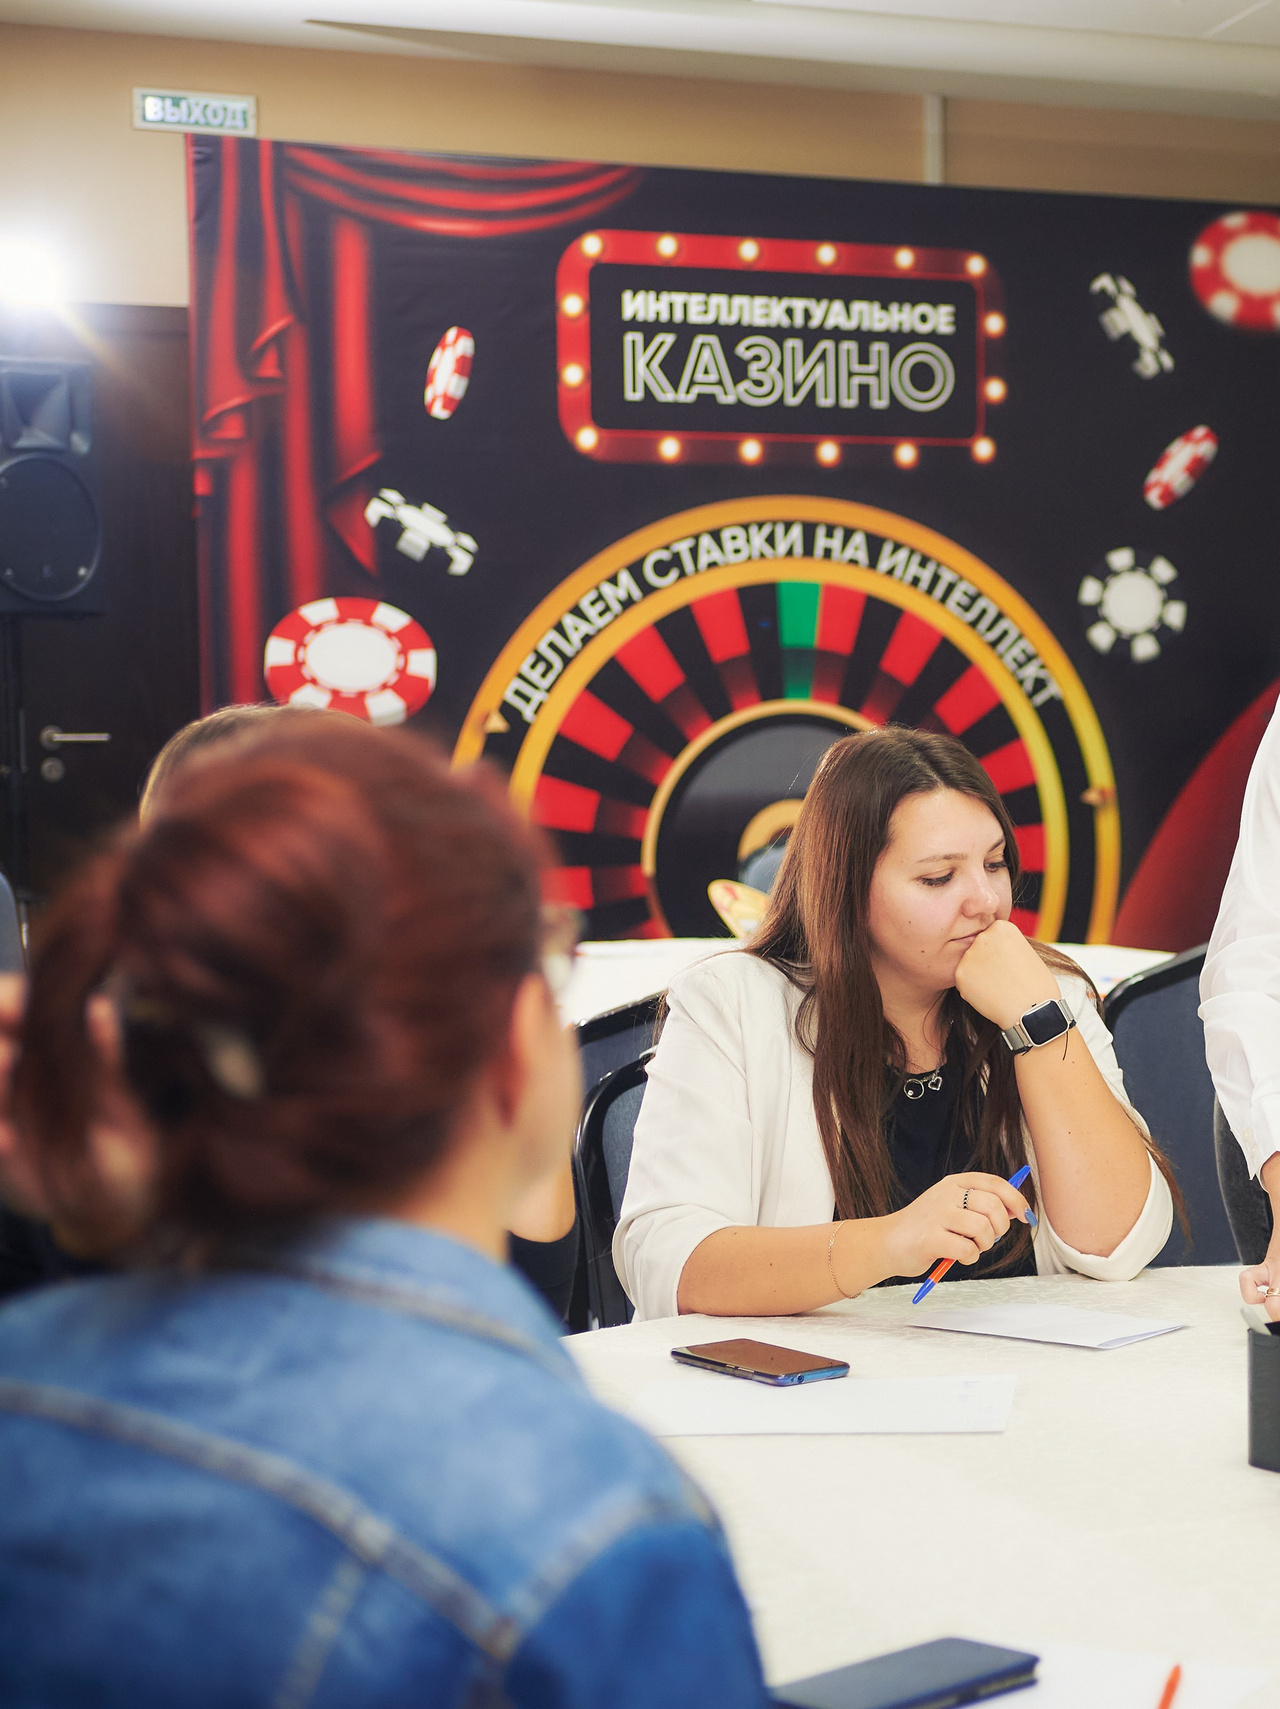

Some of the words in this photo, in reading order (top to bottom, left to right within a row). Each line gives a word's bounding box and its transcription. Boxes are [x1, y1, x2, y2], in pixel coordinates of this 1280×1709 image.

[144, 96, 247, 129] ВЫХОД
[621, 289, 956, 335] ИНТЕЛЛЕКТУАЛЬНОЕ
[623, 331, 956, 412] КАЗИНО
[503, 567, 643, 723] ДЕЛАЕМ
[642, 521, 804, 588] СТАВКИ
[813, 523, 870, 568] НА
[876, 540, 1064, 707] ИНТЕЛЛЕКТ
